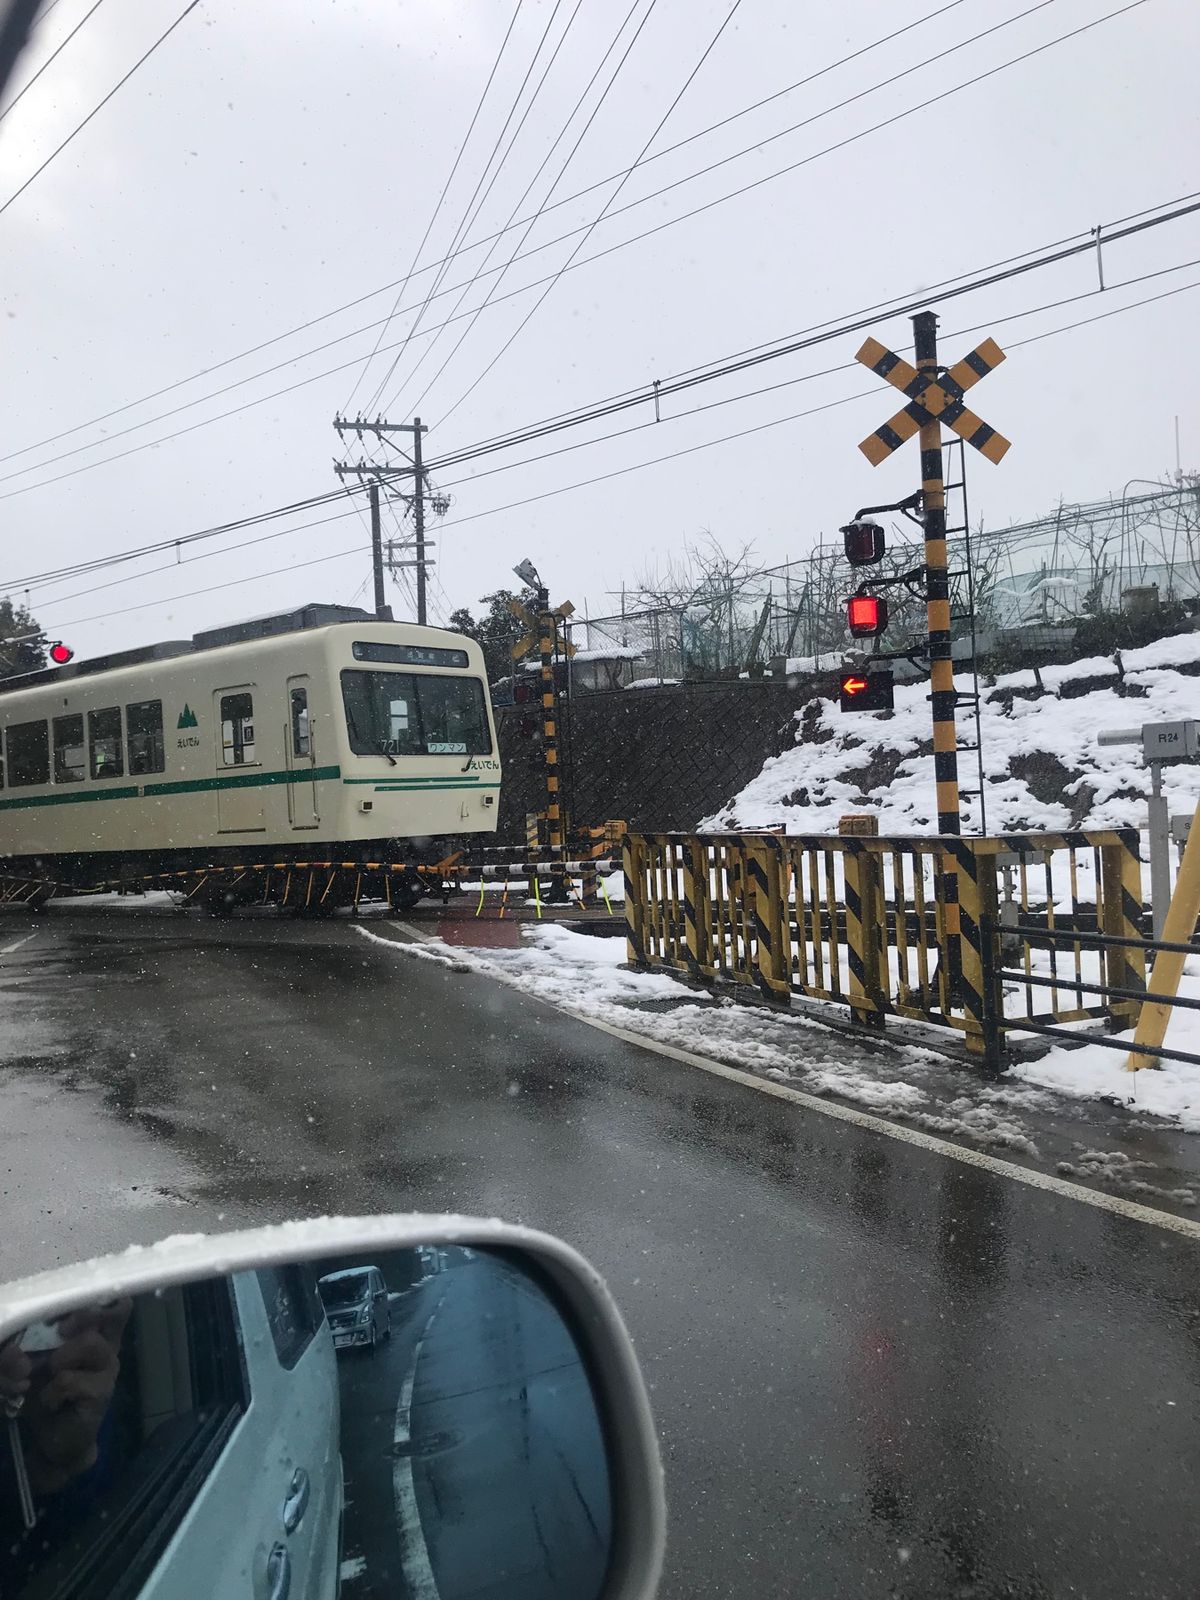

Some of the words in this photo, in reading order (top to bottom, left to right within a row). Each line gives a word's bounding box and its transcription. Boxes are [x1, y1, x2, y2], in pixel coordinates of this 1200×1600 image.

[1158, 733, 1178, 743] R24
[429, 744, 464, 752] ワンマン
[471, 760, 499, 770] えいでん
